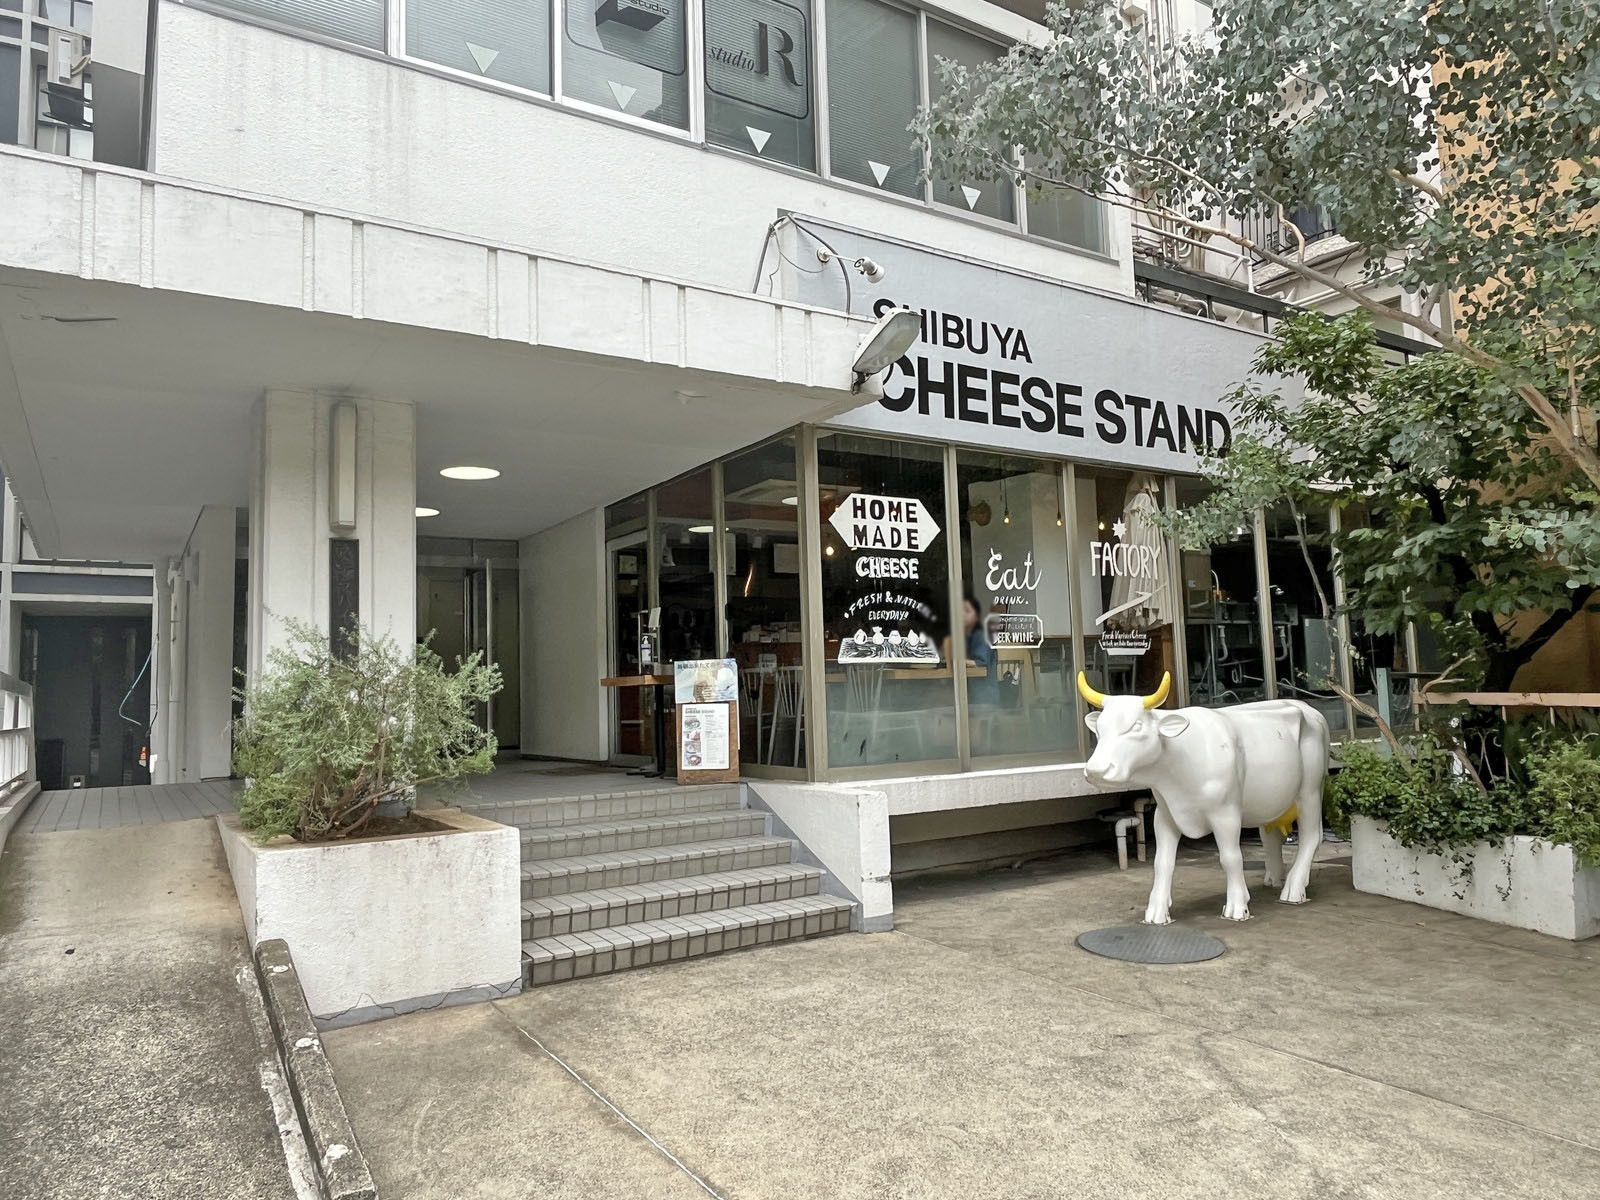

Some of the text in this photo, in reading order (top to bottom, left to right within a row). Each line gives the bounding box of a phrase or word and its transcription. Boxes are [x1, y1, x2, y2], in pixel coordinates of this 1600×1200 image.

[709, 19, 804, 87] studio R
[878, 353, 1232, 459] CHEESE STAND
[852, 497, 918, 524] HOME
[853, 524, 919, 550] MADE
[855, 556, 919, 580] CHEESE
[985, 548, 1042, 591] Eat
[1090, 541, 1160, 580] FACTORY
[849, 592, 883, 616] FRESH
[885, 590, 893, 603] &
